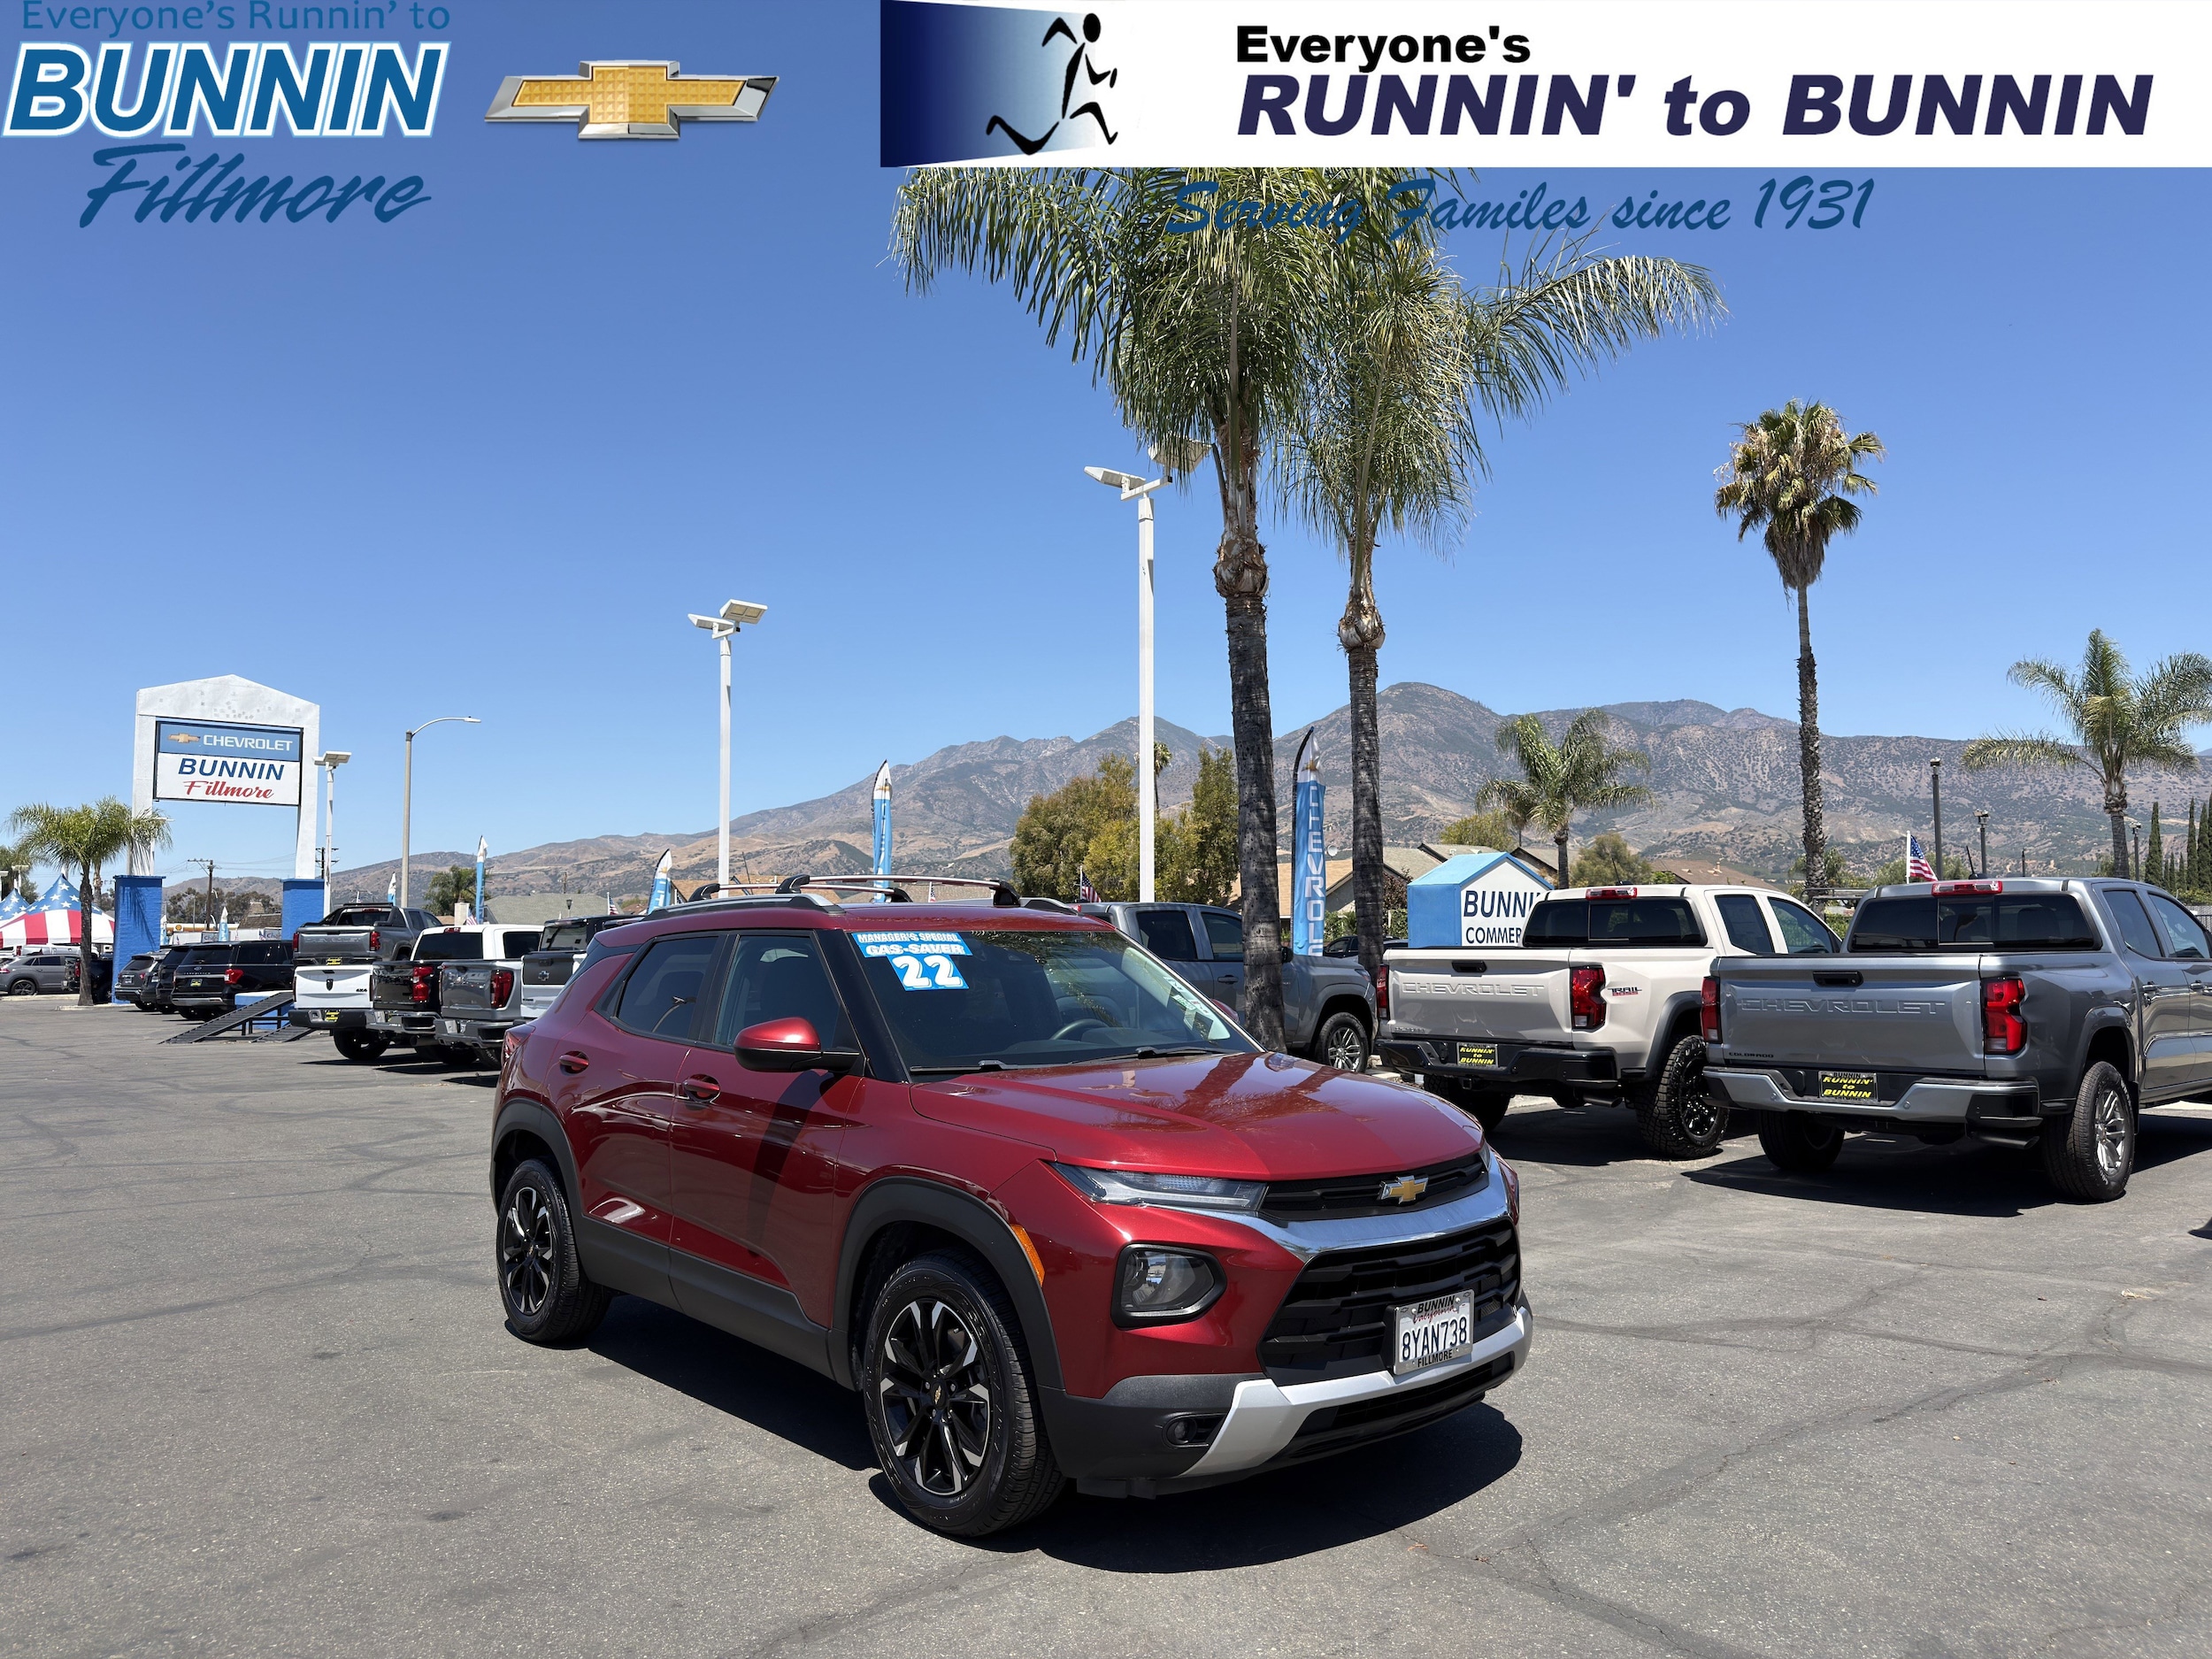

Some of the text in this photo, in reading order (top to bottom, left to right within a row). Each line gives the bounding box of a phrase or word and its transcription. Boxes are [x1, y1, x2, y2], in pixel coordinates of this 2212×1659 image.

[203, 733, 293, 751] CHEVROLET
[178, 757, 285, 780] BUNNIN
[182, 780, 275, 799] Fillmore
[1463, 889, 1541, 918] BUNNI
[856, 932, 962, 943] MANAGER'S SPECIAL
[865, 943, 966, 955] GAS-SAVER
[891, 955, 964, 988] 22
[1402, 981, 1545, 997] CHEVROLET
[1739, 998, 1946, 1015] CHEVROLET
[1823, 1089, 1872, 1098] BUNNIN
[1417, 1294, 1455, 1314] BUNNIN
[1402, 1316, 1468, 1361] 8YAN738
[1417, 1348, 1453, 1368] FILLMORE
